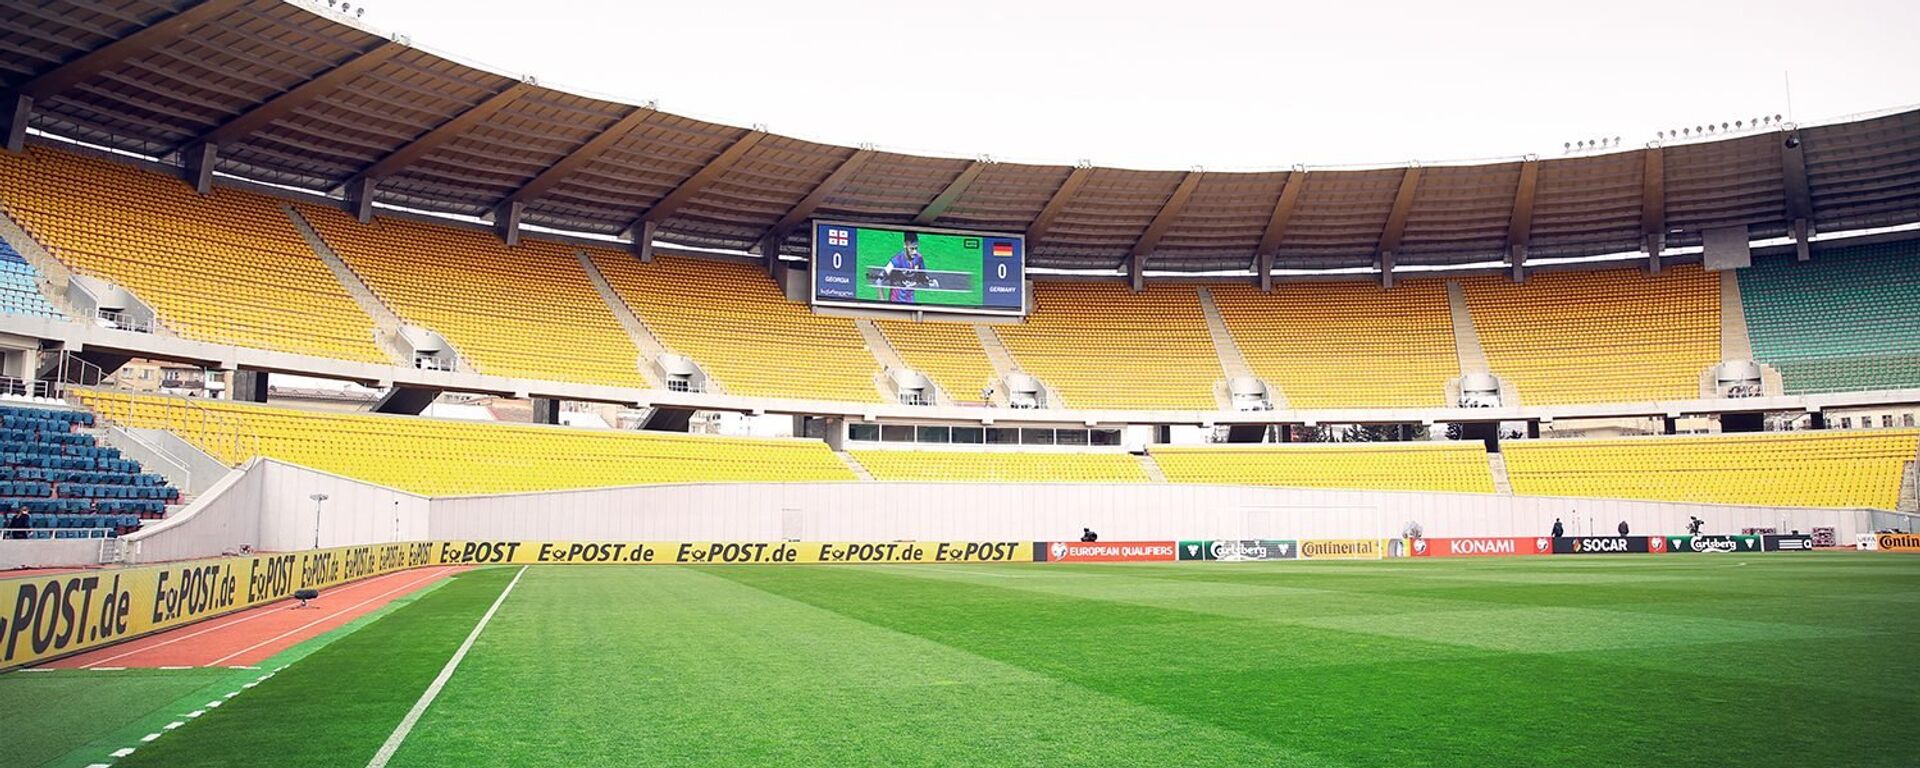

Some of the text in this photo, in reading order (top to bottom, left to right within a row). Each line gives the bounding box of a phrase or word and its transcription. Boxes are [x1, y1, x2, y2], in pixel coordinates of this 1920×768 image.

[833, 253, 842, 269] 0
[997, 263, 1007, 279] 0
[1069, 546, 1173, 557] EUROPEAN QUALIFIERS
[1210, 540, 1267, 558] Carlsberg
[1301, 541, 1372, 557] Continental
[1451, 539, 1515, 554] KONAMI
[1582, 538, 1628, 552] SOCAR
[1690, 535, 1737, 552] Carlsberg
